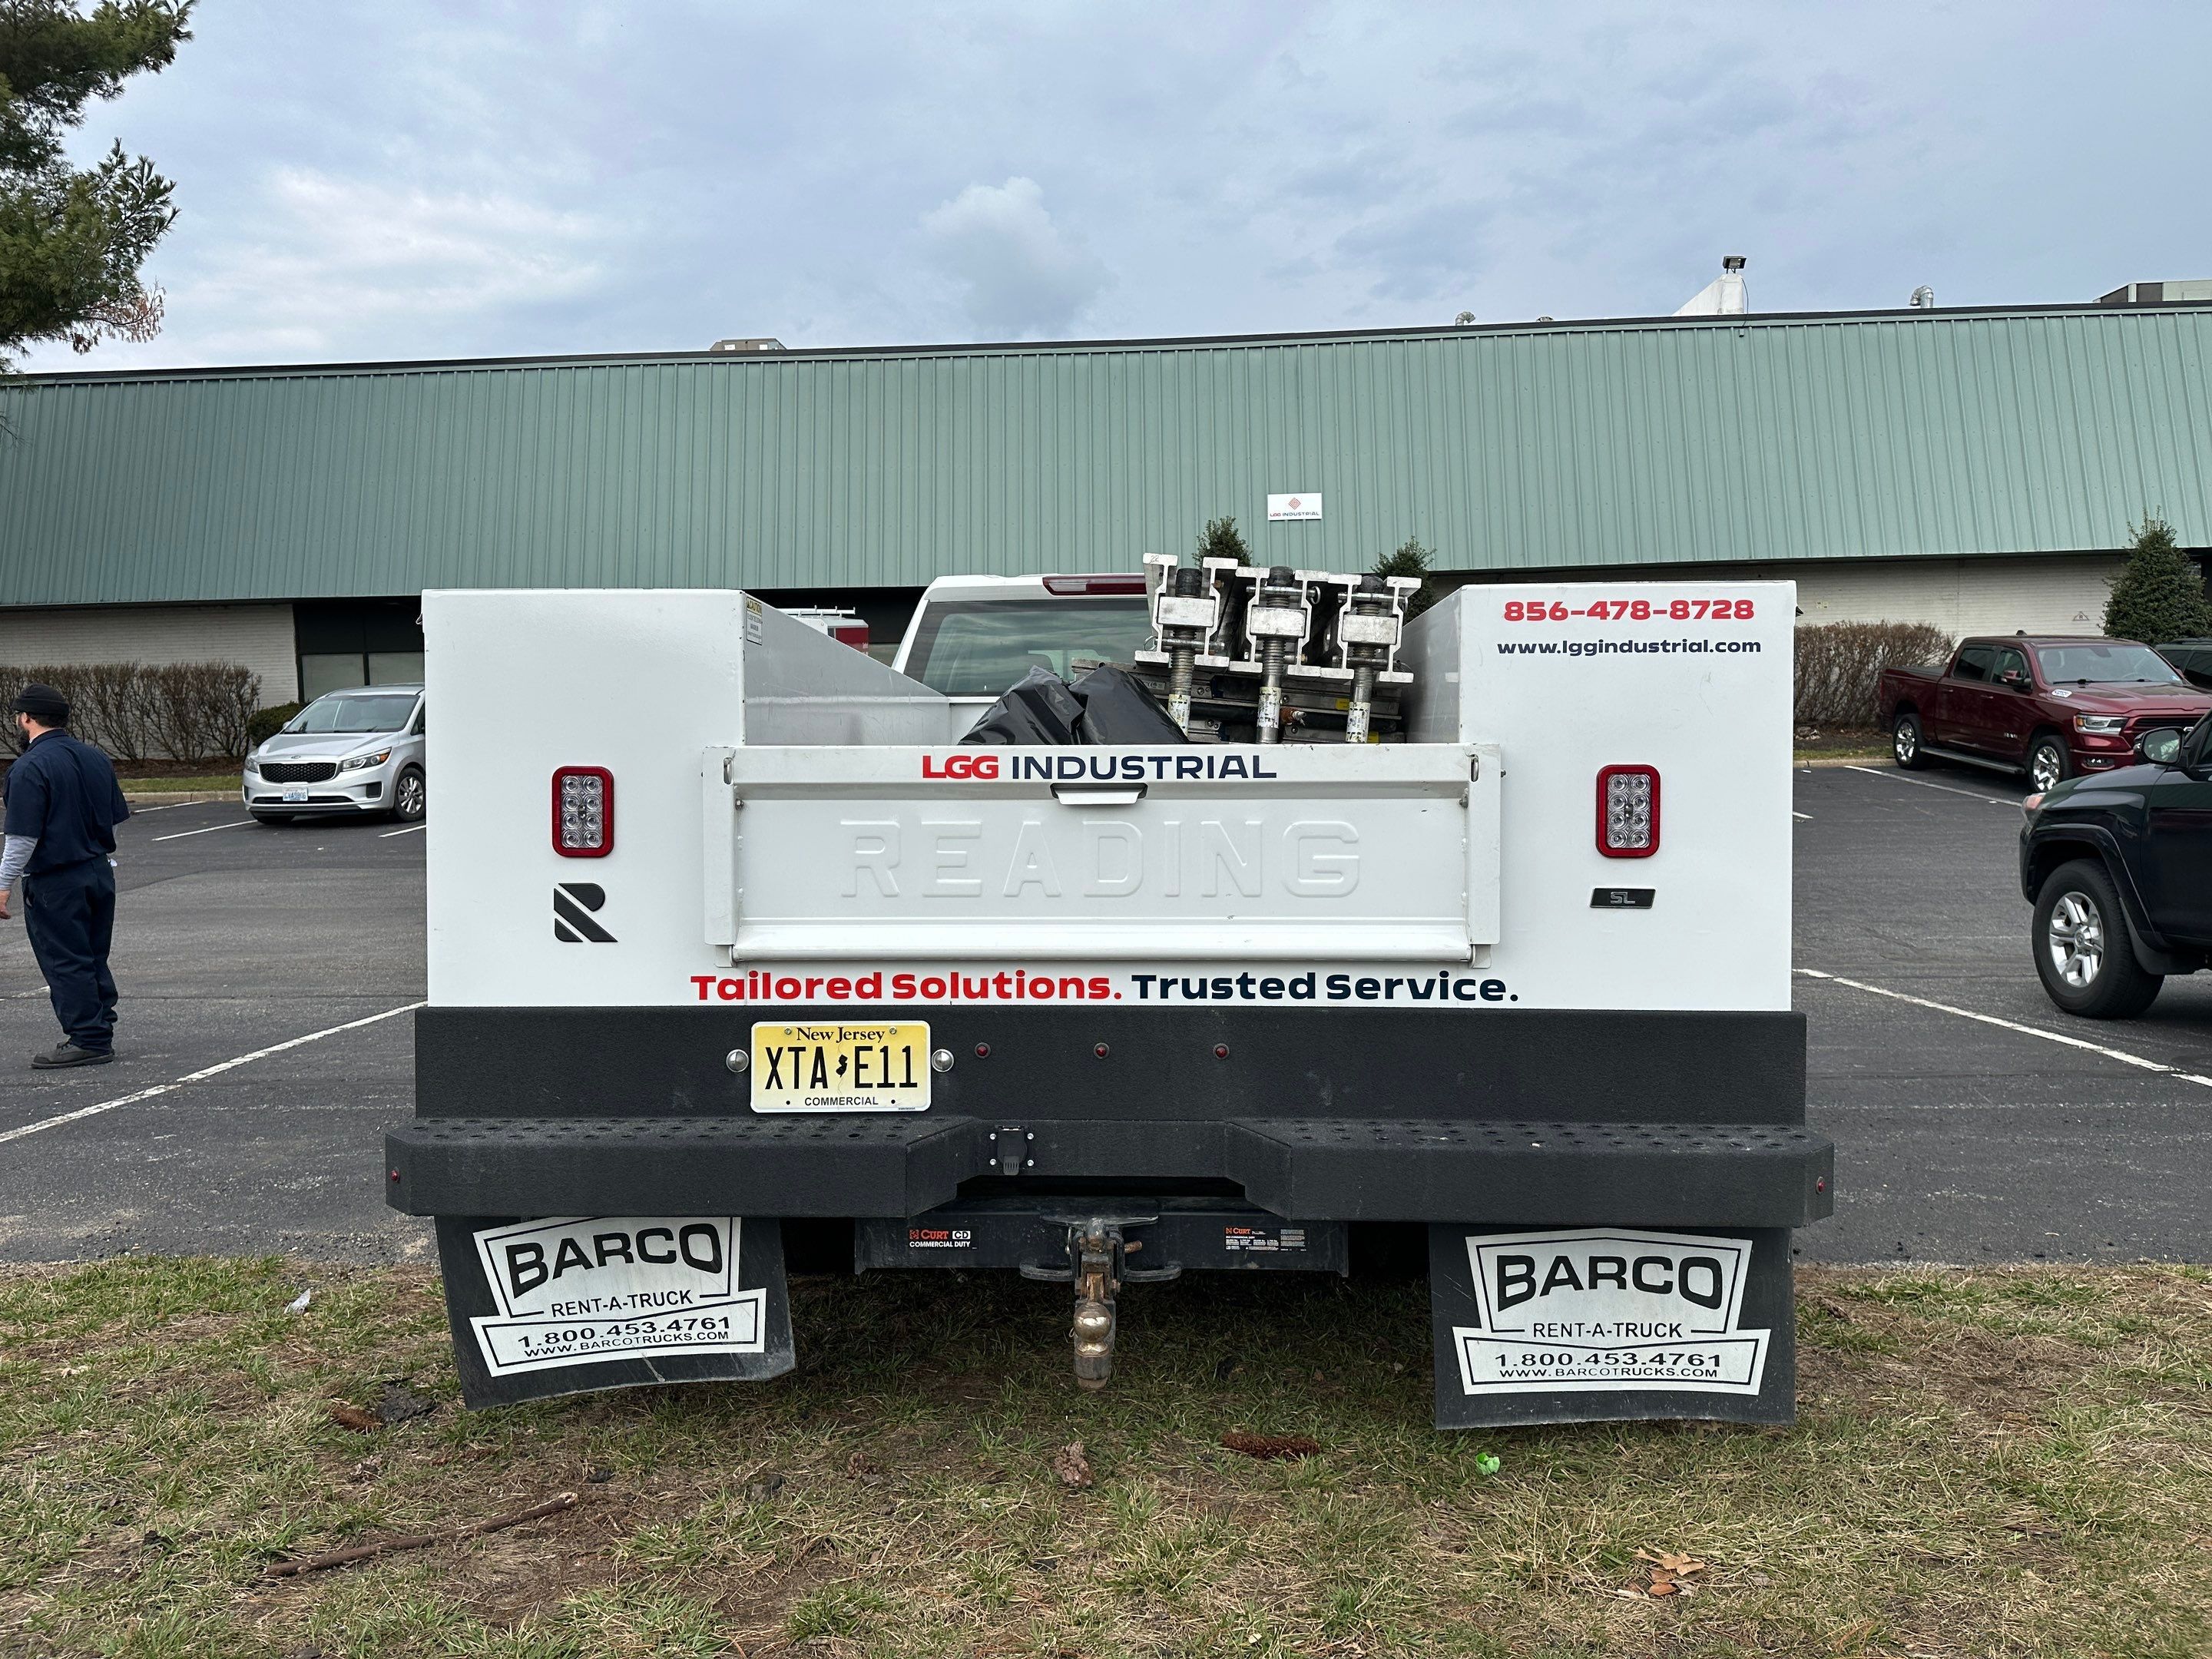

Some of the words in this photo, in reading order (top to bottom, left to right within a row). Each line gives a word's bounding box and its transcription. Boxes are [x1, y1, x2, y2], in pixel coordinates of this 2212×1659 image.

[1503, 599, 1755, 621] 856-478-8728
[1497, 638, 1761, 657] www.lggindustrial.com
[922, 755, 999, 780] LGG
[1012, 755, 1278, 780] INDUSTRIAL
[840, 820, 1360, 899] READING
[1610, 891, 1636, 904] SL
[690, 970, 882, 1001] Tailored
[892, 969, 1122, 1000] Solutions.
[1131, 972, 1316, 1000] Trusted
[1326, 970, 1518, 1002] Service.
[796, 1027, 832, 1041] New
[836, 1026, 886, 1044] Jersey
[764, 1046, 829, 1090] XTA
[854, 1045, 918, 1088] E11
[804, 1096, 879, 1106] COMMERCIAL
[505, 1223, 723, 1299] BARCO
[1496, 1254, 1723, 1313] BARCO
[551, 1289, 694, 1317] RENT-A-TRUCK
[518, 1316, 730, 1348] 1.800.453.4761
[1533, 1322, 1683, 1338] RENT-A-TRUCK
[524, 1330, 729, 1357] WWW.BARCOTRUCKS.COM
[1495, 1353, 1720, 1367] 1.800.453.4761
[1499, 1367, 1718, 1378] WWW.BARCOTRUCKS.COM
